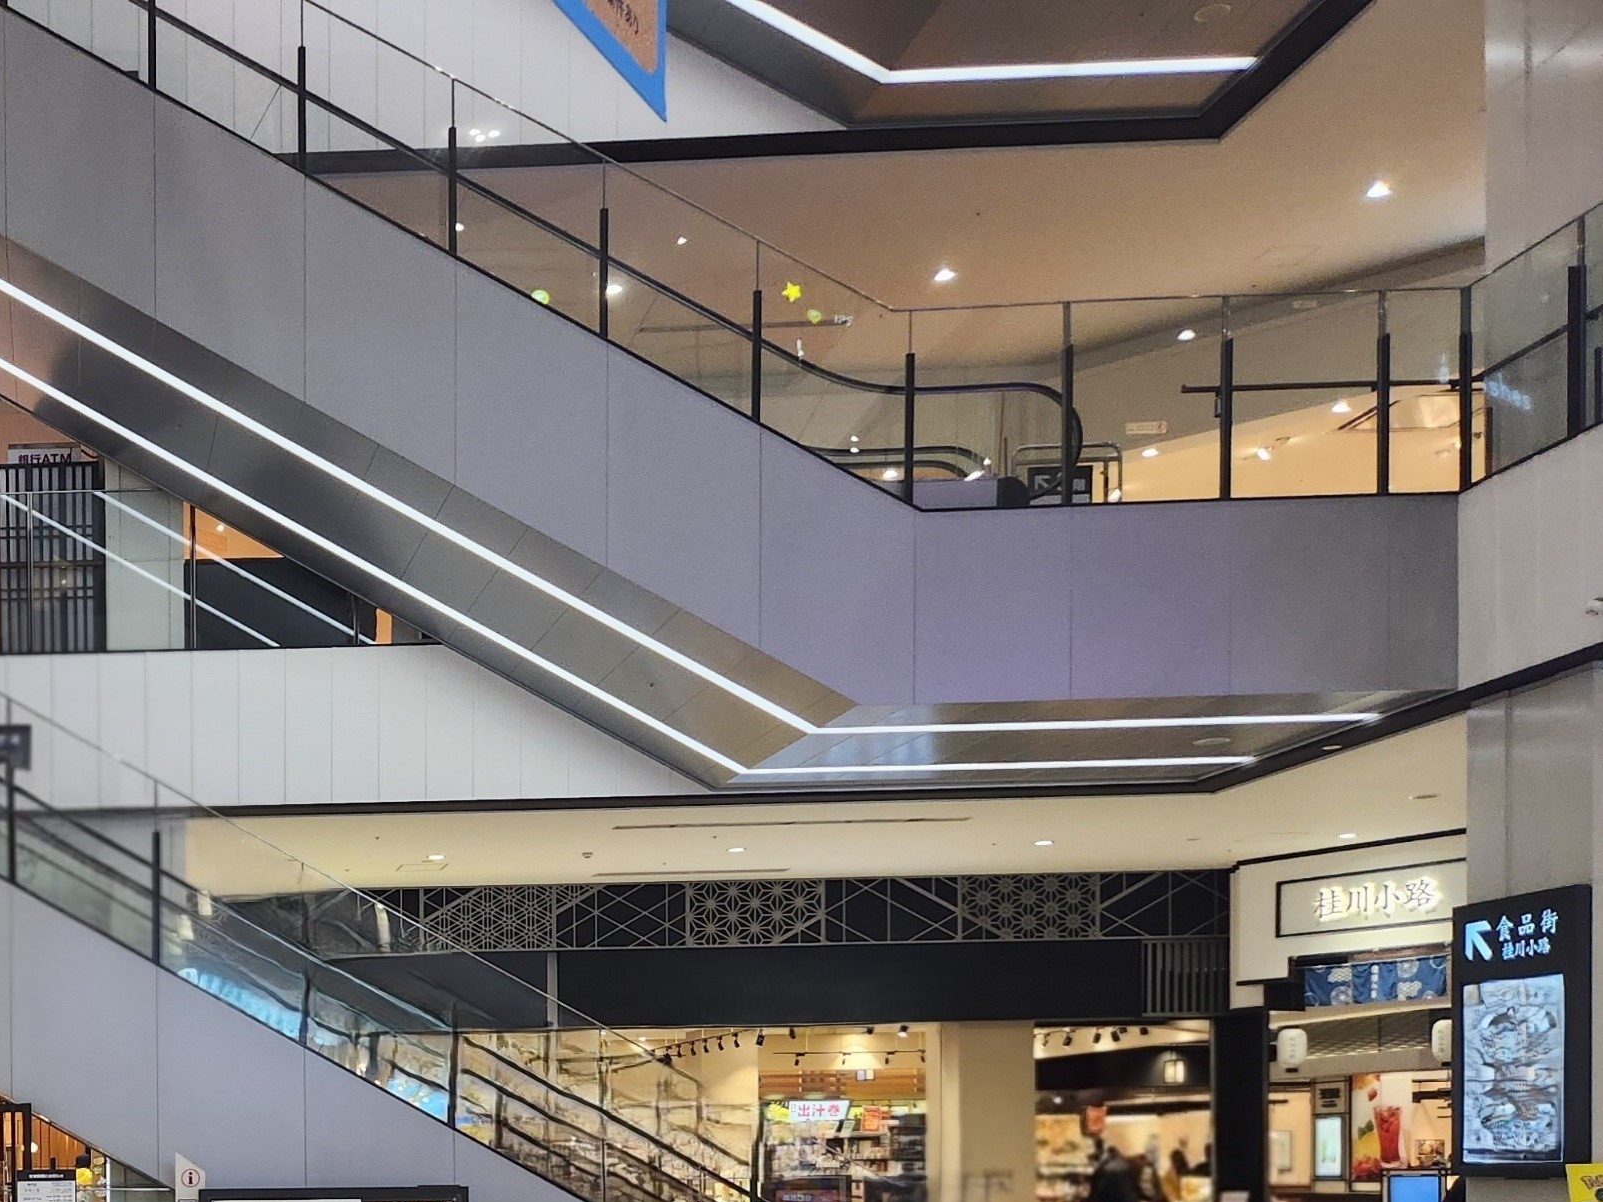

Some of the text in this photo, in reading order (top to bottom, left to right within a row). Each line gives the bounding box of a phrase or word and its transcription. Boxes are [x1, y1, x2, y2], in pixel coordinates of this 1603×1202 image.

[1314, 879, 1433, 918] 桂川小路
[1496, 908, 1558, 941] 食品街
[1501, 937, 1551, 960] 桂川小路
